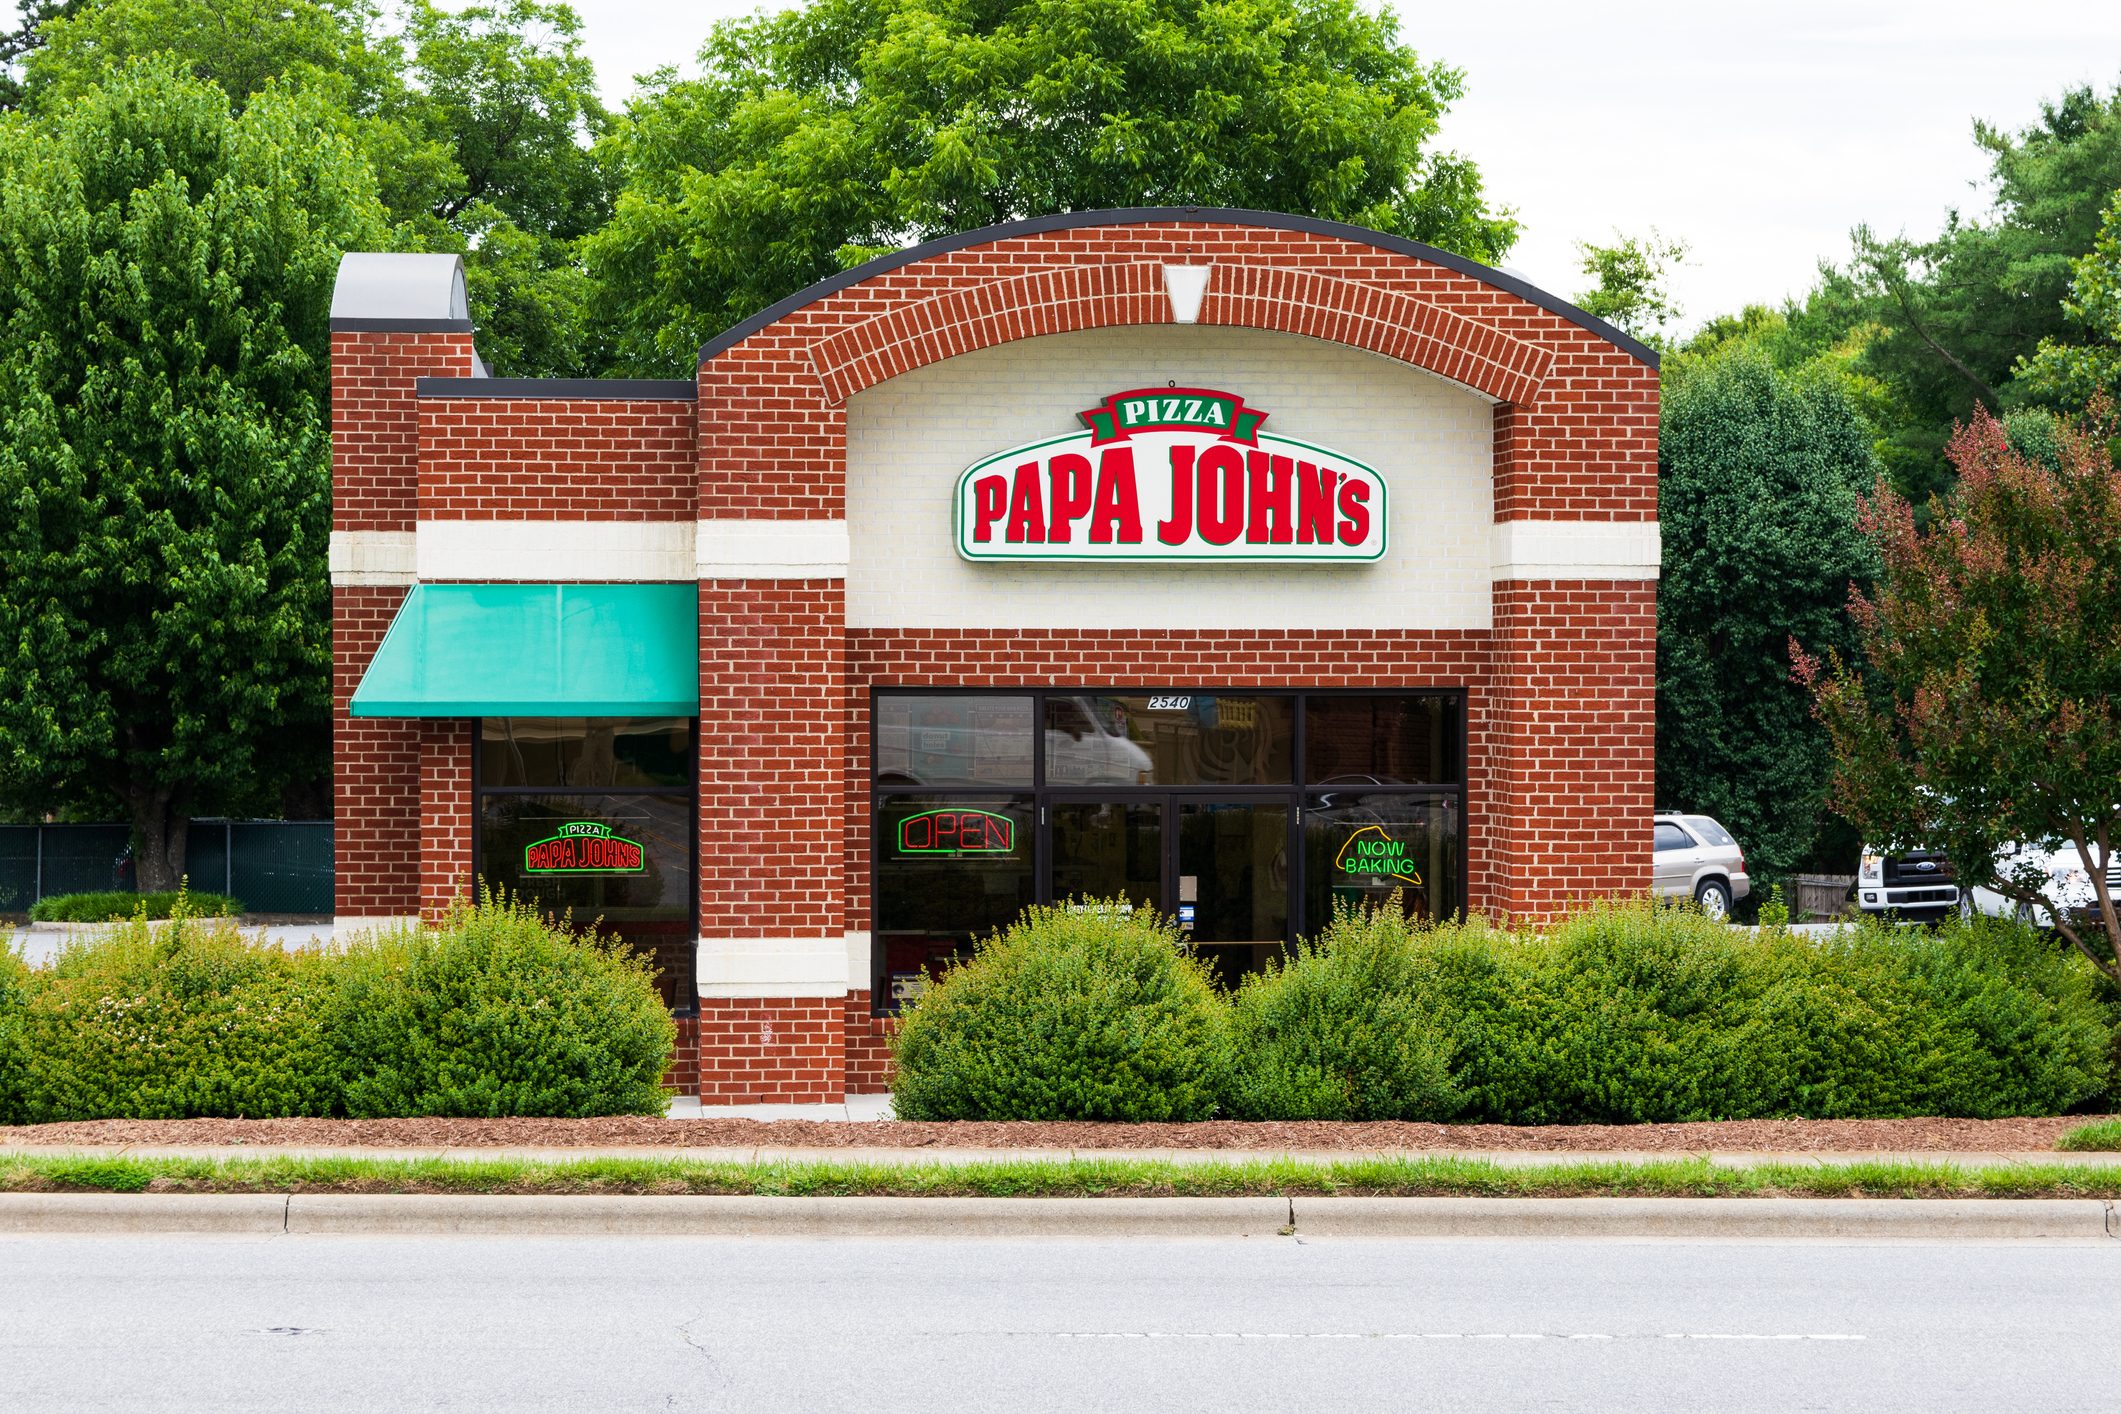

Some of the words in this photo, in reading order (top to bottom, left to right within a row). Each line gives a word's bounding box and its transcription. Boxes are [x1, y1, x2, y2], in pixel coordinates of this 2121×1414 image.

[1123, 399, 1226, 425] PIZZA
[974, 446, 1143, 544] PAPA
[1157, 445, 1370, 546] JOHN'S
[1150, 696, 1189, 709] 2540
[569, 824, 600, 835] PIZZA
[905, 813, 1009, 849] OPEN
[528, 838, 576, 868] PAPA
[578, 837, 641, 868] JOHN'S
[1357, 840, 1405, 856] NOW
[1345, 858, 1414, 874] BAKING
